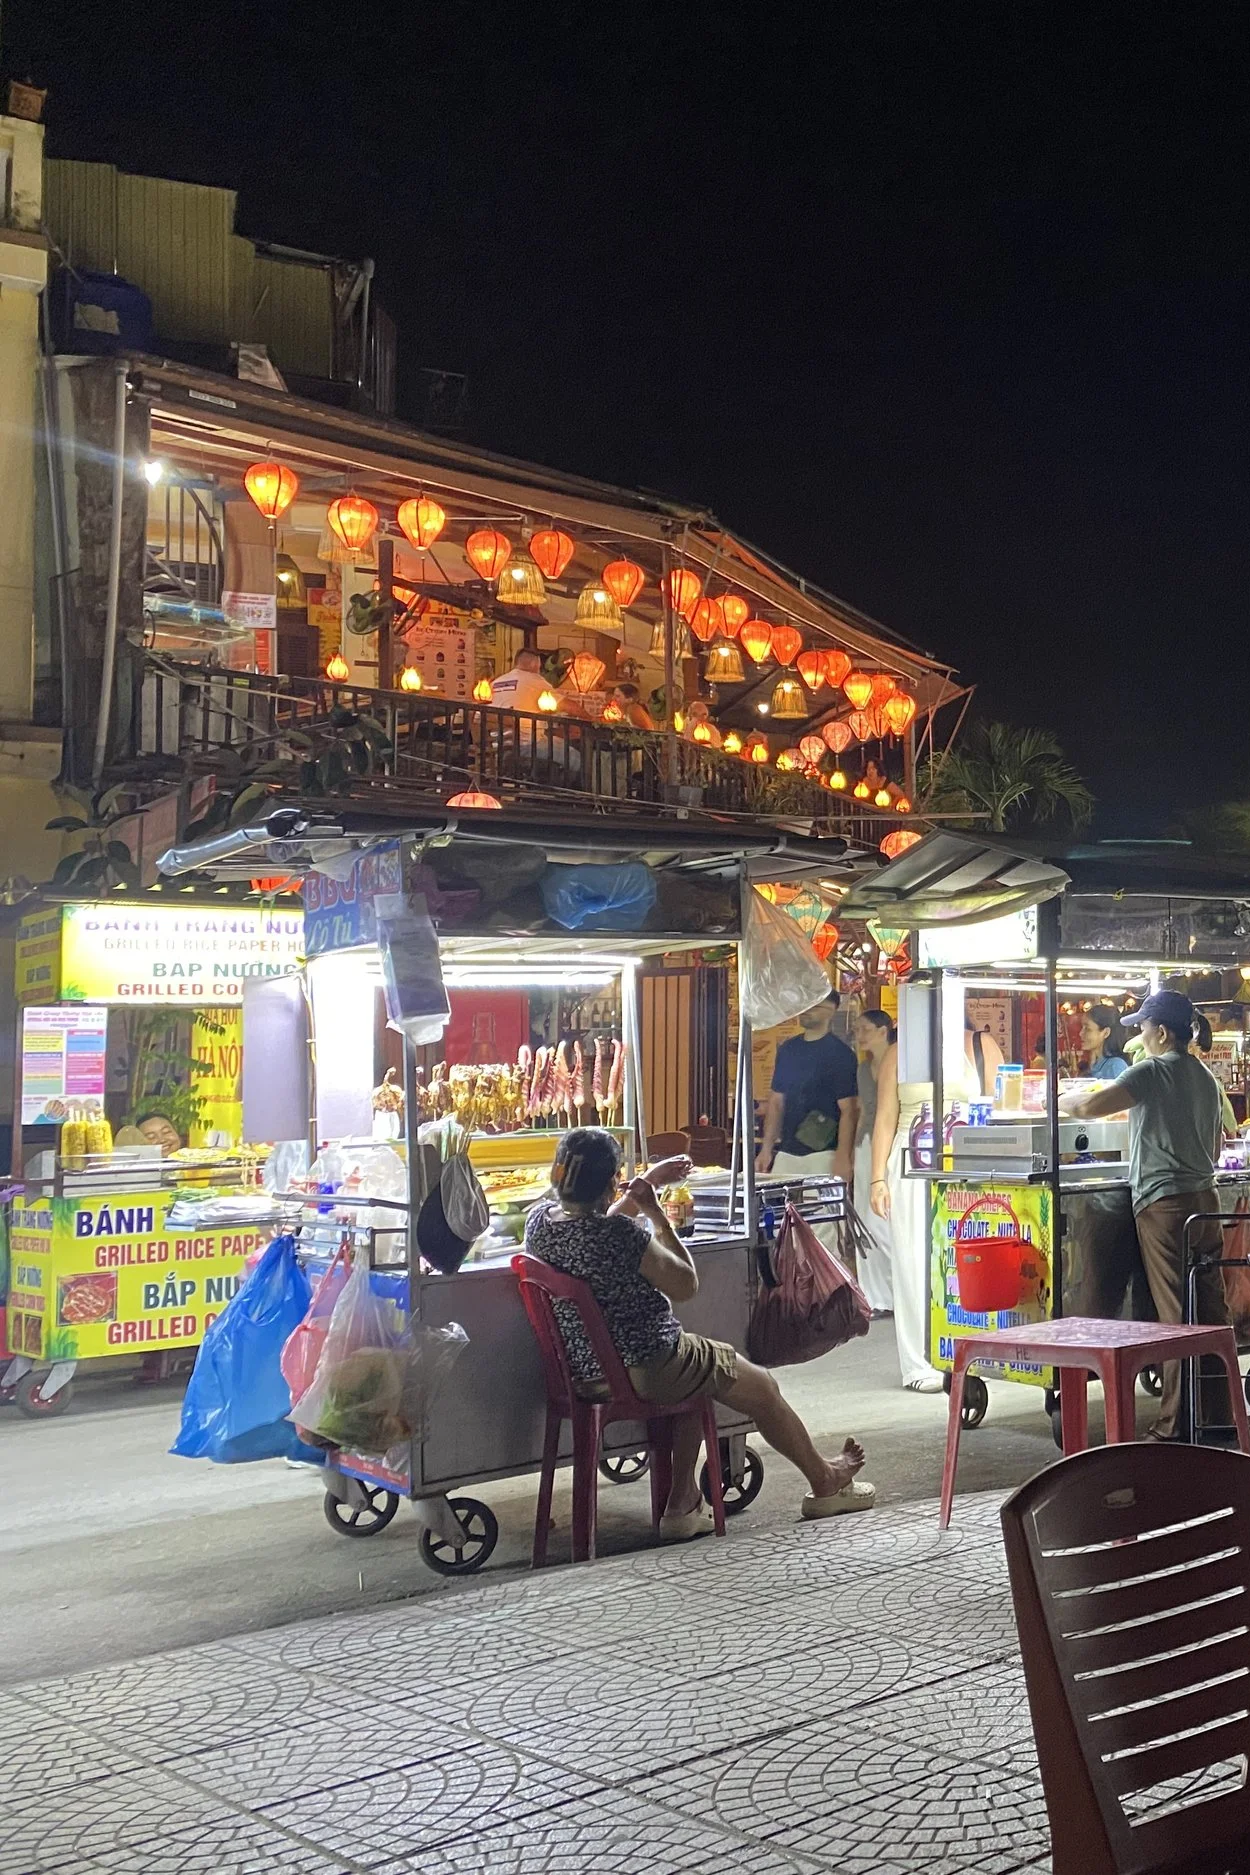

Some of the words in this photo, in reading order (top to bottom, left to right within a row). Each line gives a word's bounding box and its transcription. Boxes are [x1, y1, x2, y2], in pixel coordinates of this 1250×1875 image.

[228, 940, 281, 952] PAPER
[117, 983, 204, 996] GRILLED
[75, 1204, 154, 1237] BÁNH
[94, 1241, 169, 1268] GRILLED
[174, 1237, 216, 1261] RICE
[221, 1232, 265, 1257] PAPE
[107, 1315, 197, 1345] GRILLED
